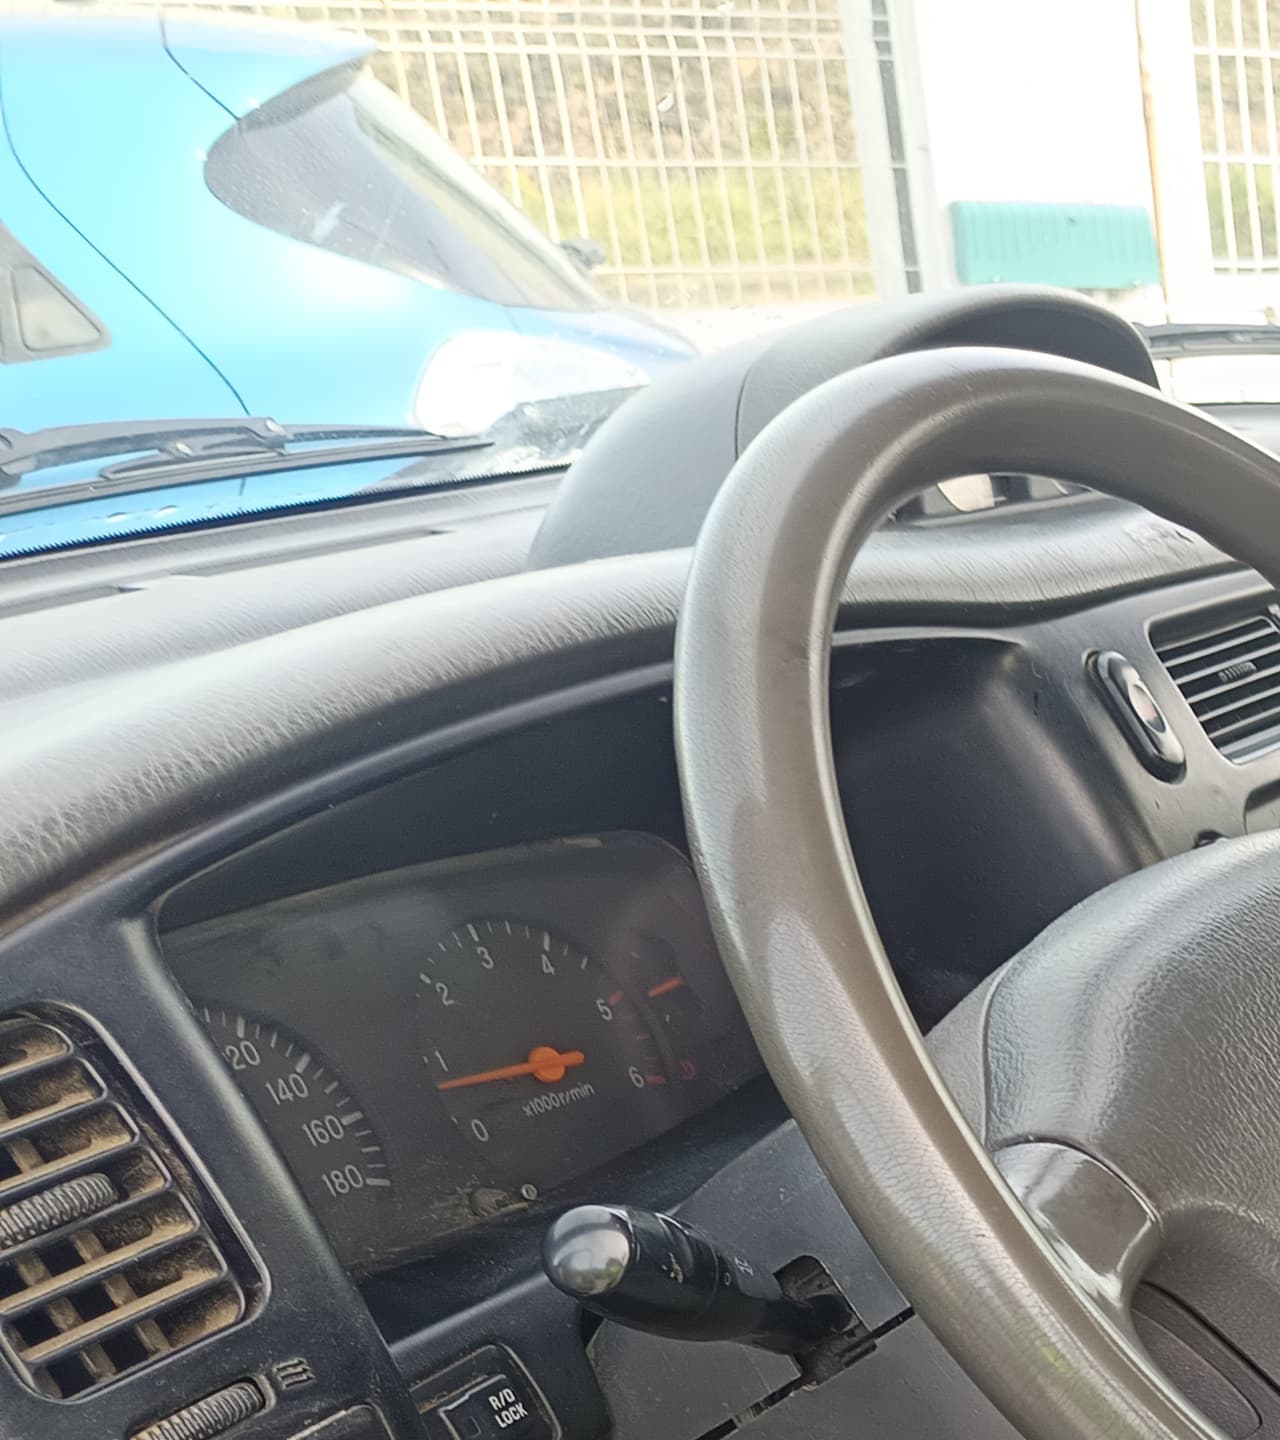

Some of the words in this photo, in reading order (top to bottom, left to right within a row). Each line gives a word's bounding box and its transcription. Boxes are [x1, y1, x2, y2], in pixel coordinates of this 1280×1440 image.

[476, 946, 494, 969] 3
[541, 953, 555, 975] 4
[435, 982, 455, 1006] 2
[596, 997, 613, 1021] 5
[628, 1065, 645, 1089] 6
[265, 1073, 309, 1106] 140
[302, 1114, 345, 1147] 160
[470, 1118, 489, 1142] 0
[321, 1164, 364, 1198] 180
[488, 1387, 516, 1411] R/D
[494, 1401, 529, 1429] LOCK
